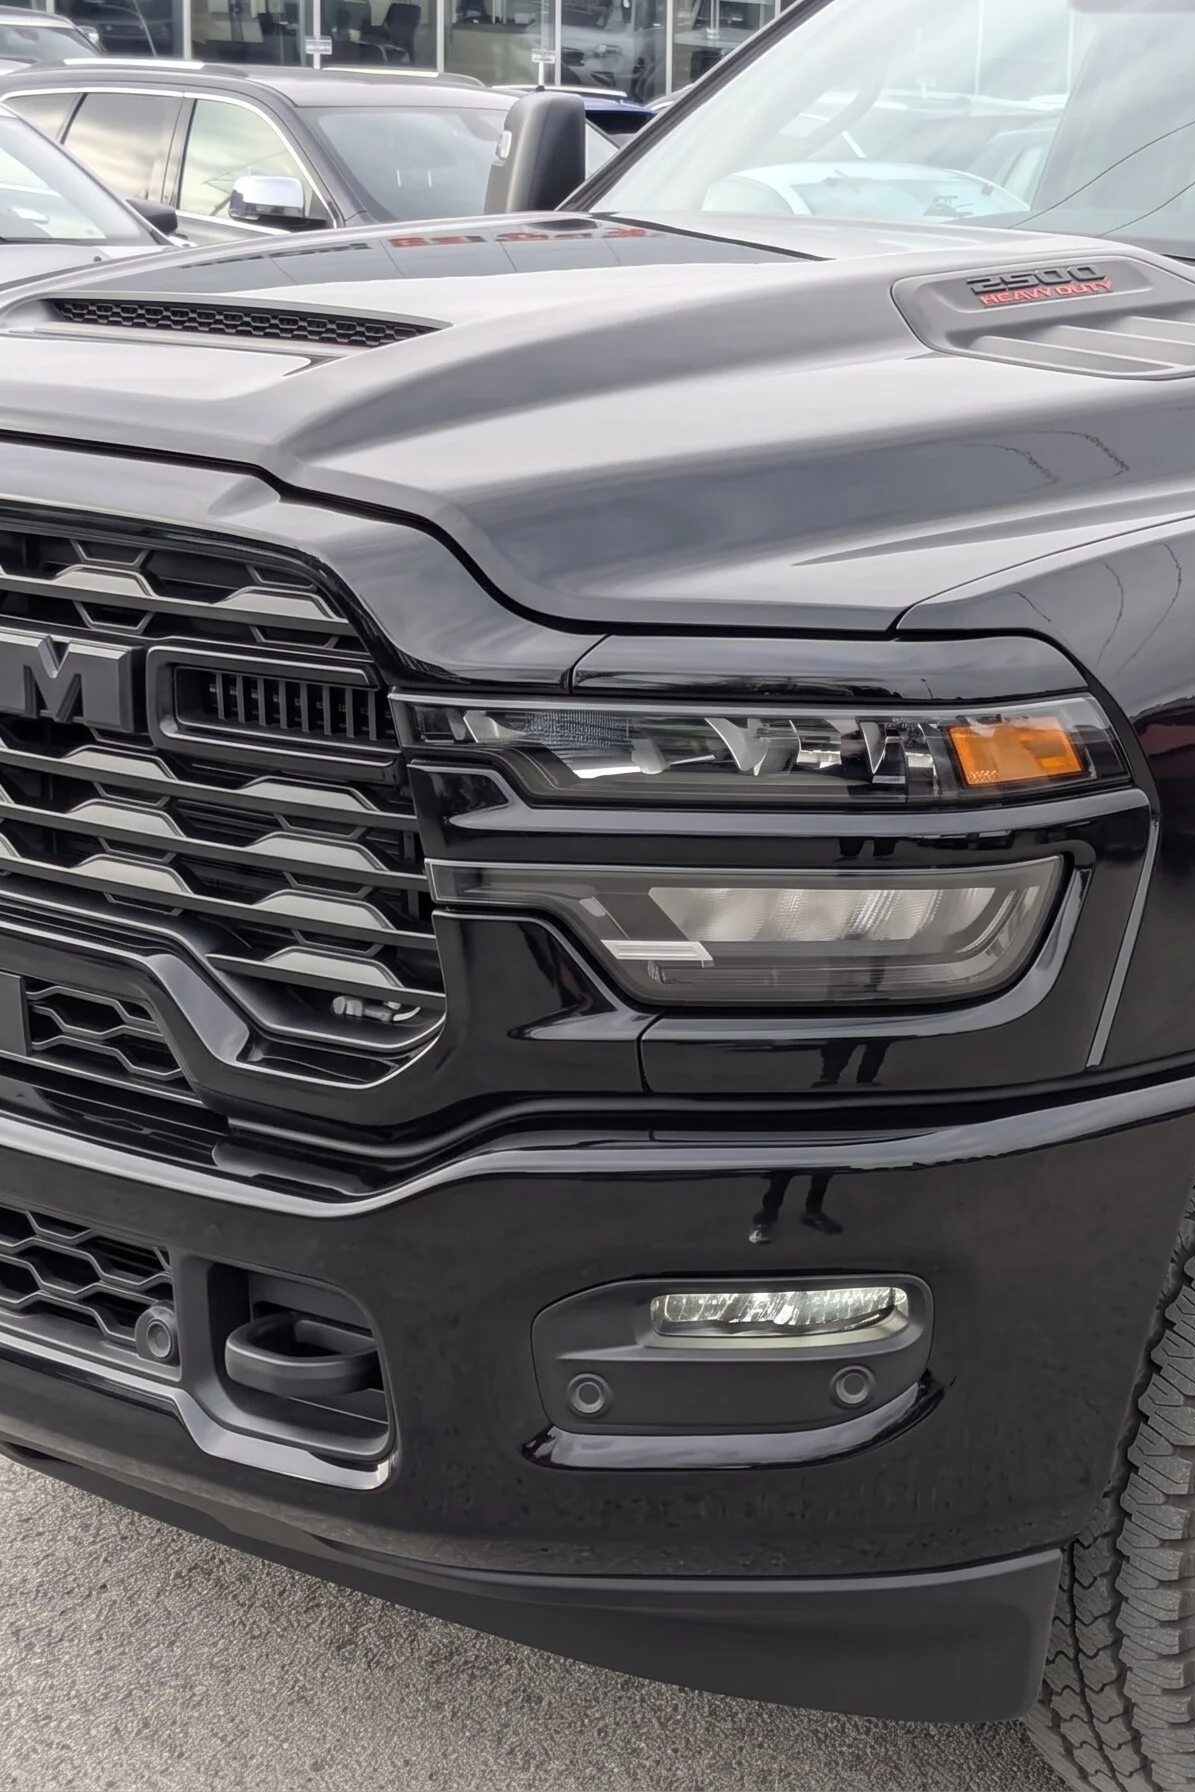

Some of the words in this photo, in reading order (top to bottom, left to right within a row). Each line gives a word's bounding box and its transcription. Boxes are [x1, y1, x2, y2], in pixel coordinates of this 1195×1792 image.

[966, 264, 1106, 295] 2500
[979, 286, 1052, 306] HEAVY
[1054, 279, 1114, 299] DUTY
